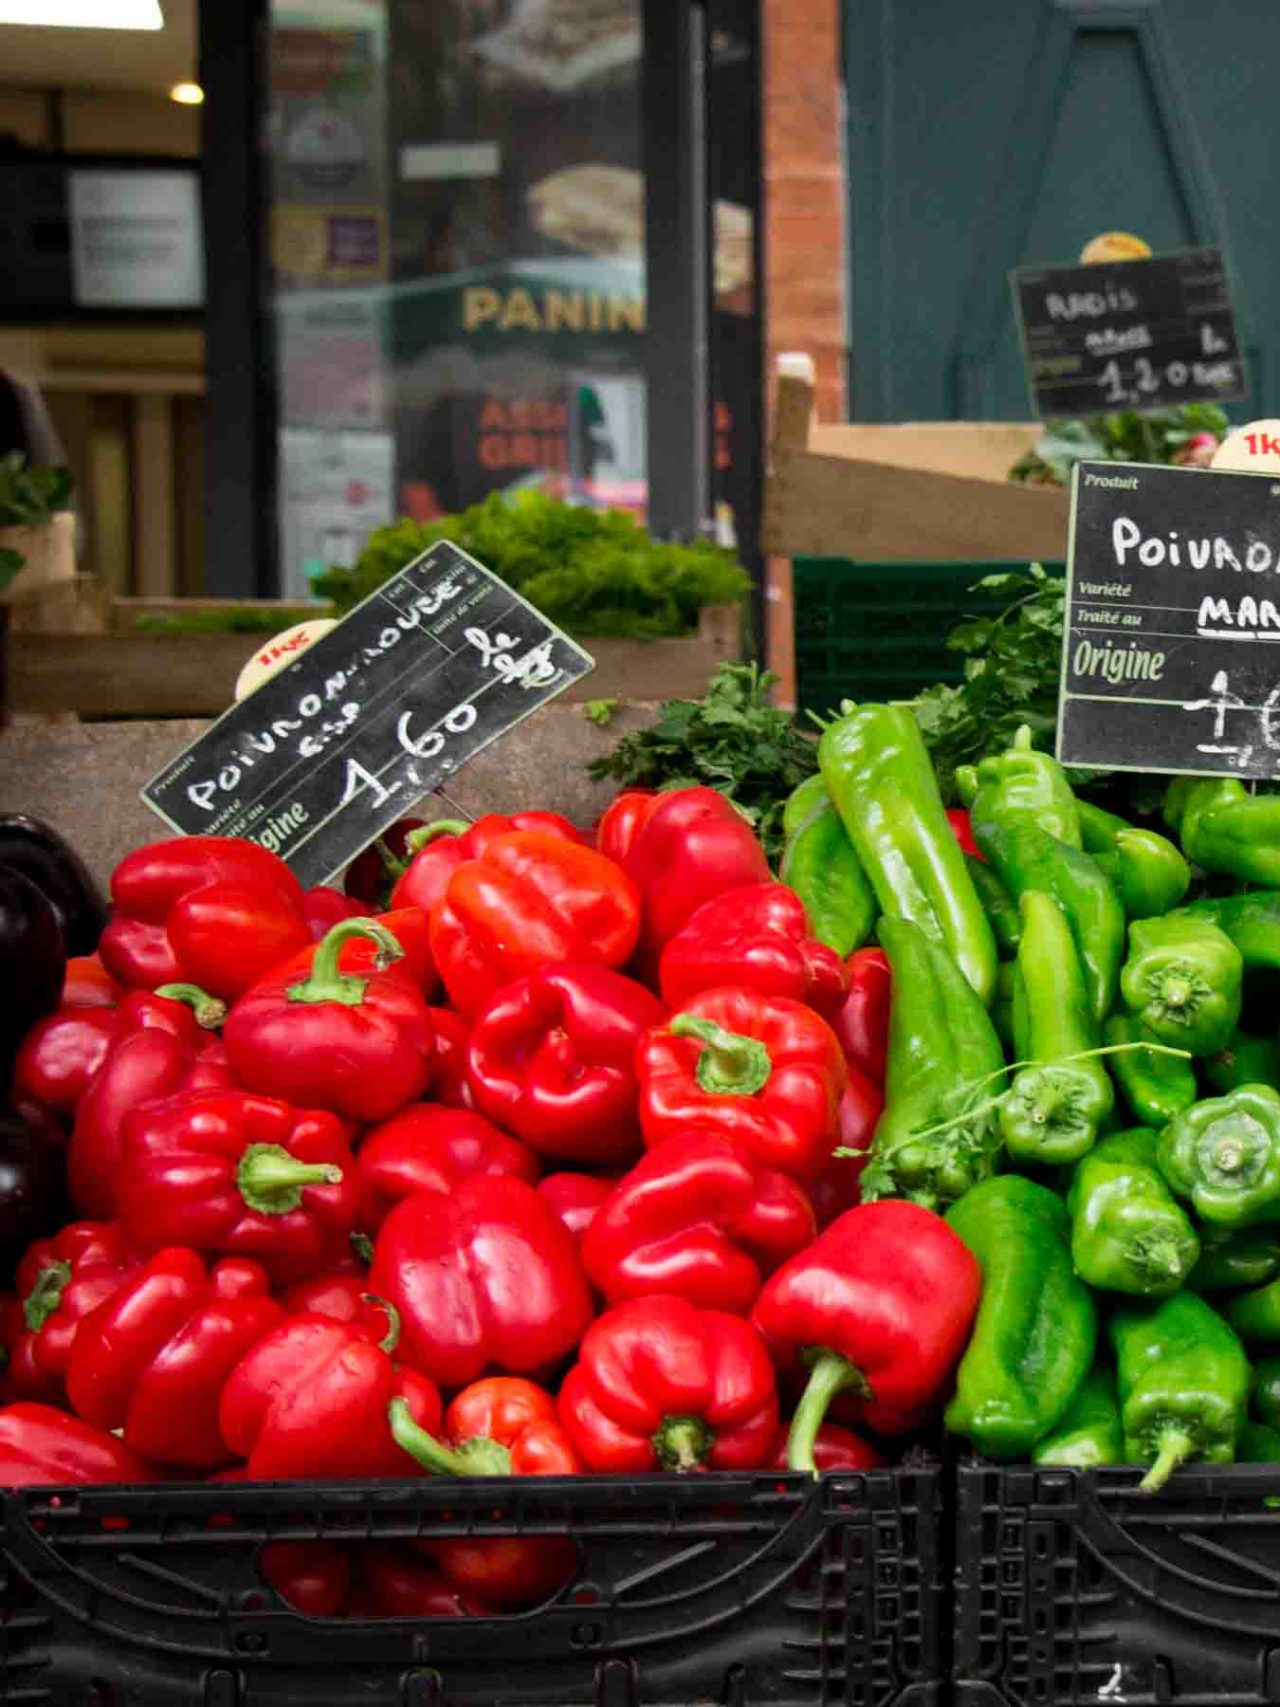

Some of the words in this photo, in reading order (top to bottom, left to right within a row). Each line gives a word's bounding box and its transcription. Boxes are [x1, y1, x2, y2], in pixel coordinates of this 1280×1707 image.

[1084, 472, 1139, 491] Produit
[1078, 580, 1133, 597] Variété
[1077, 608, 1121, 625] Traité
[1122, 614, 1142, 626] au
[1073, 639, 1166, 684] Origine
